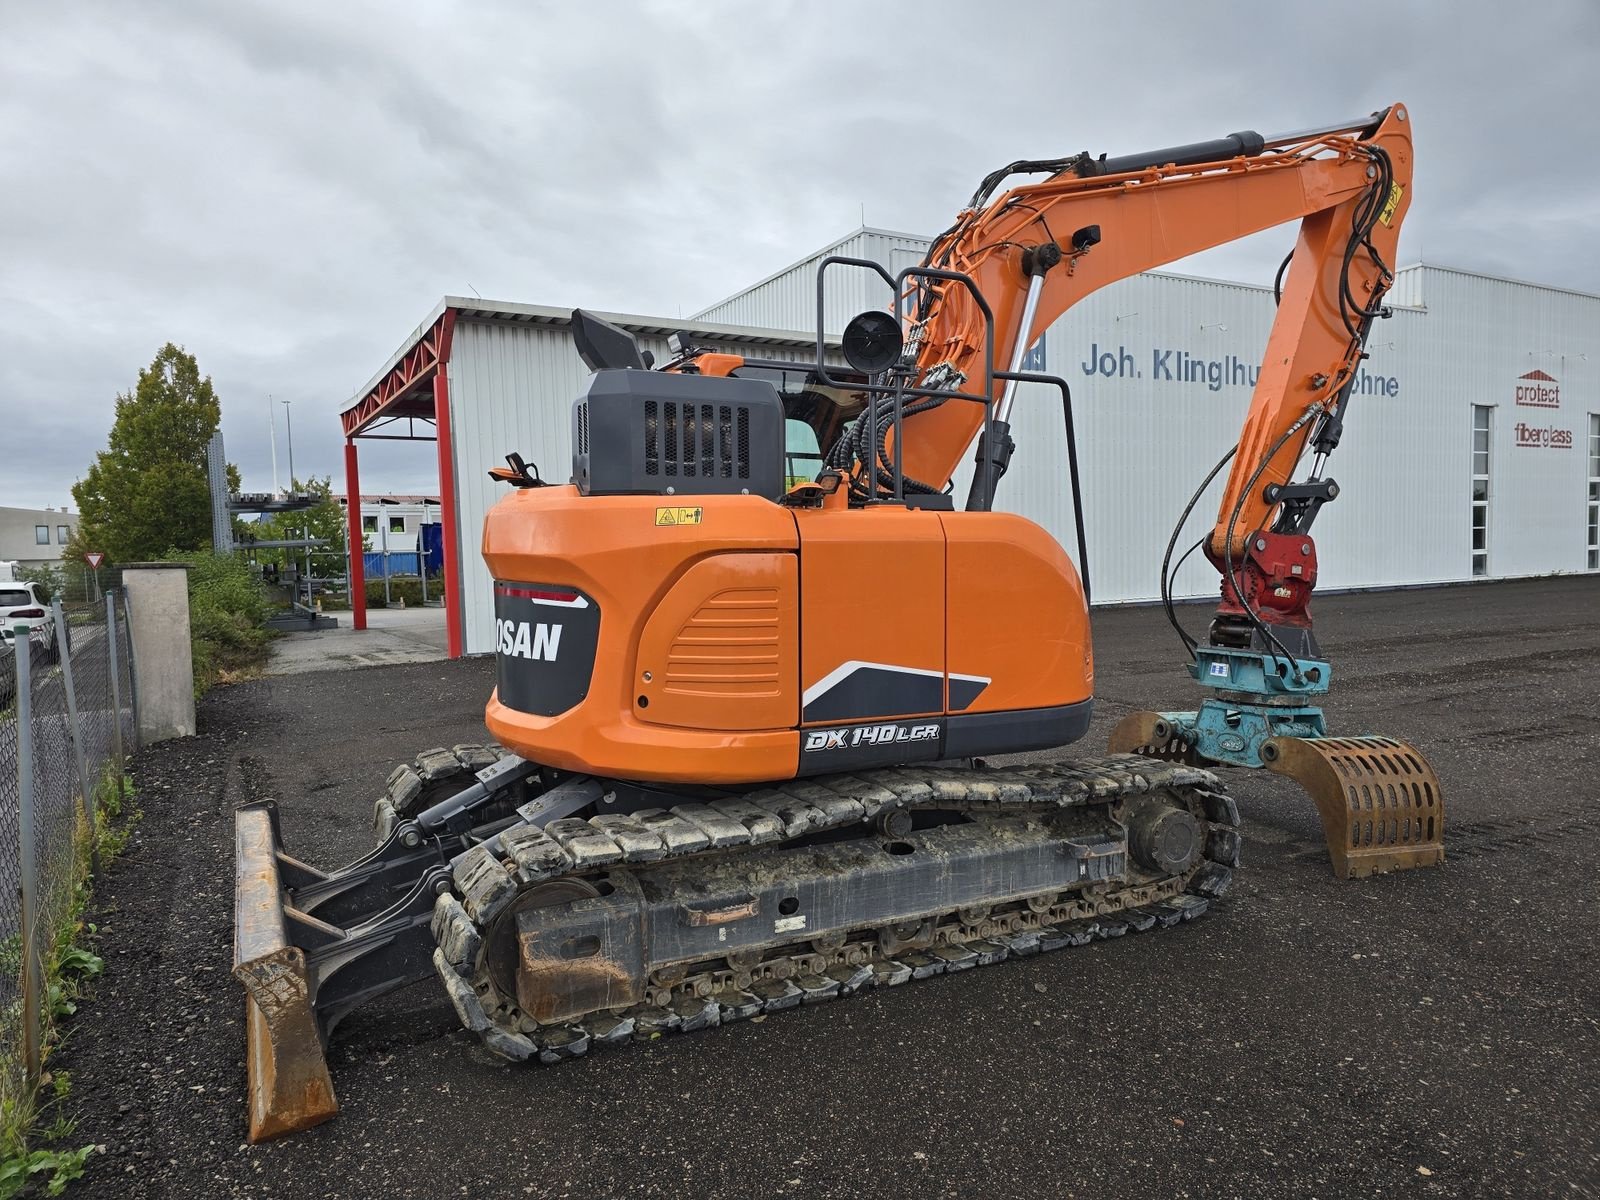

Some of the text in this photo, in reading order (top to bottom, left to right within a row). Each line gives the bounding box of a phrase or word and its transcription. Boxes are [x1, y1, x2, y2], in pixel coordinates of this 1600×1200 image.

[1081, 343, 1141, 378] Joh.
[1152, 348, 1262, 392] Klinglhu
[1515, 384, 1560, 406] protect
[1514, 422, 1573, 448] fiberglass
[496, 618, 563, 662] OSAN
[805, 728, 850, 752] DX
